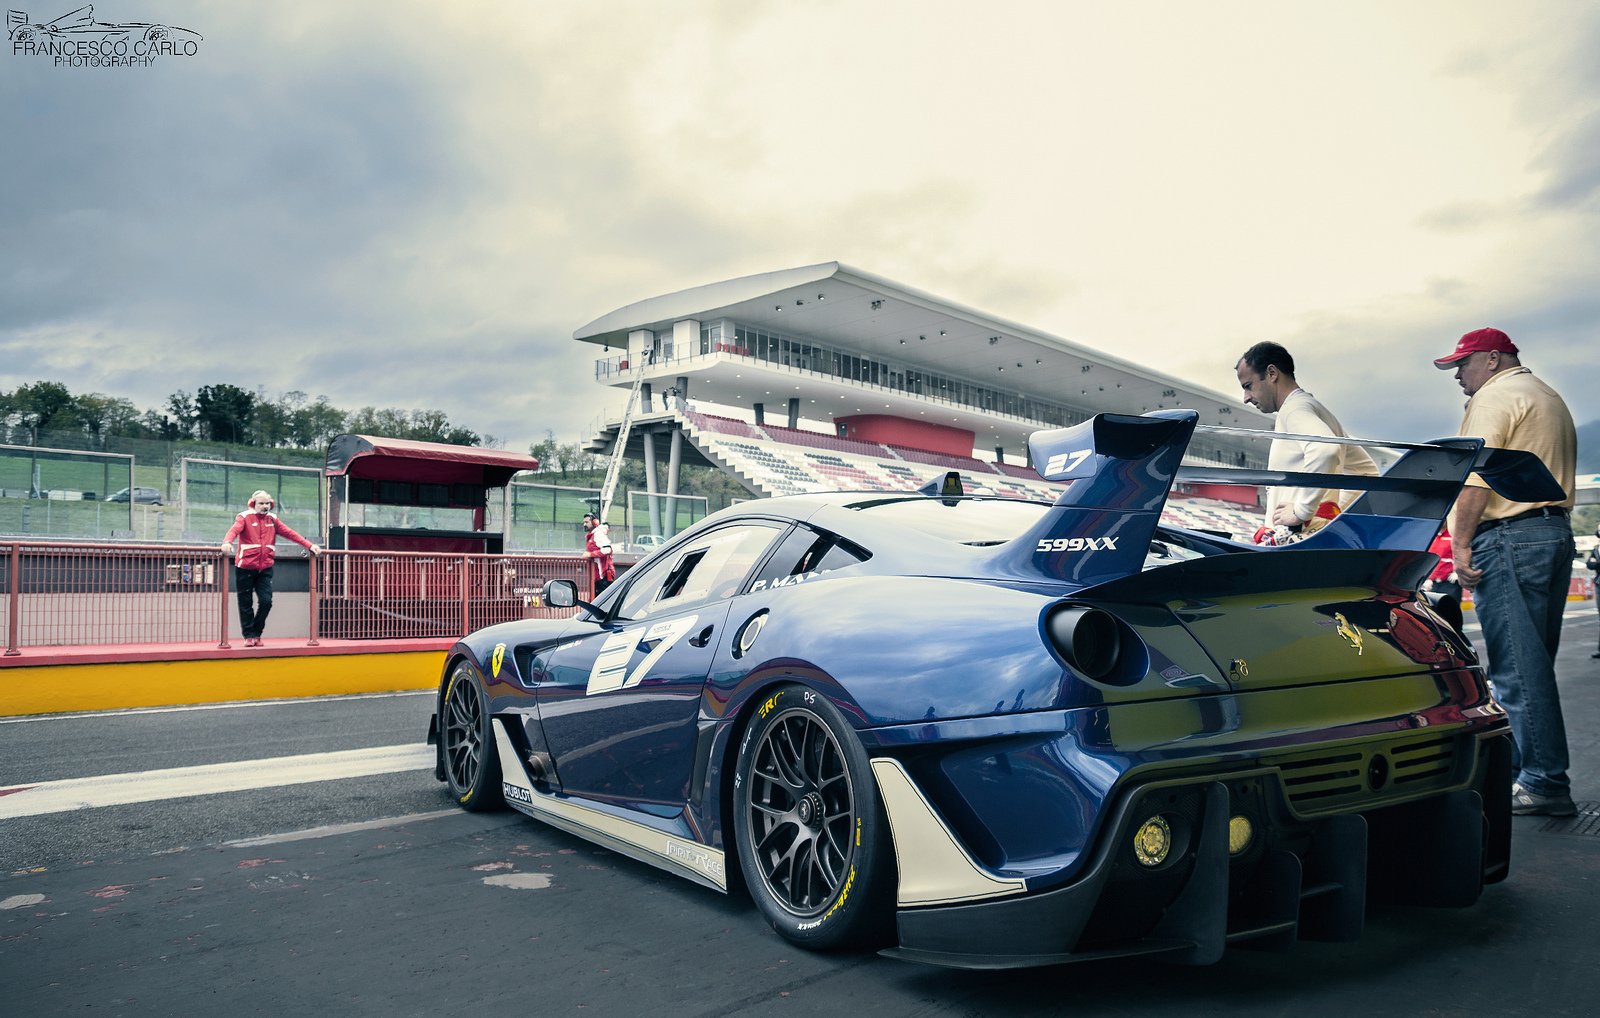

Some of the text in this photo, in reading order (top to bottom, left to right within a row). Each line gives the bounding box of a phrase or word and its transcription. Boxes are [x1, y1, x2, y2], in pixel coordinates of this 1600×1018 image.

[1044, 448, 1092, 477] 27
[1036, 536, 1119, 552] 599XX
[585, 614, 699, 697] 27
[503, 783, 531, 802] HUBLOT
